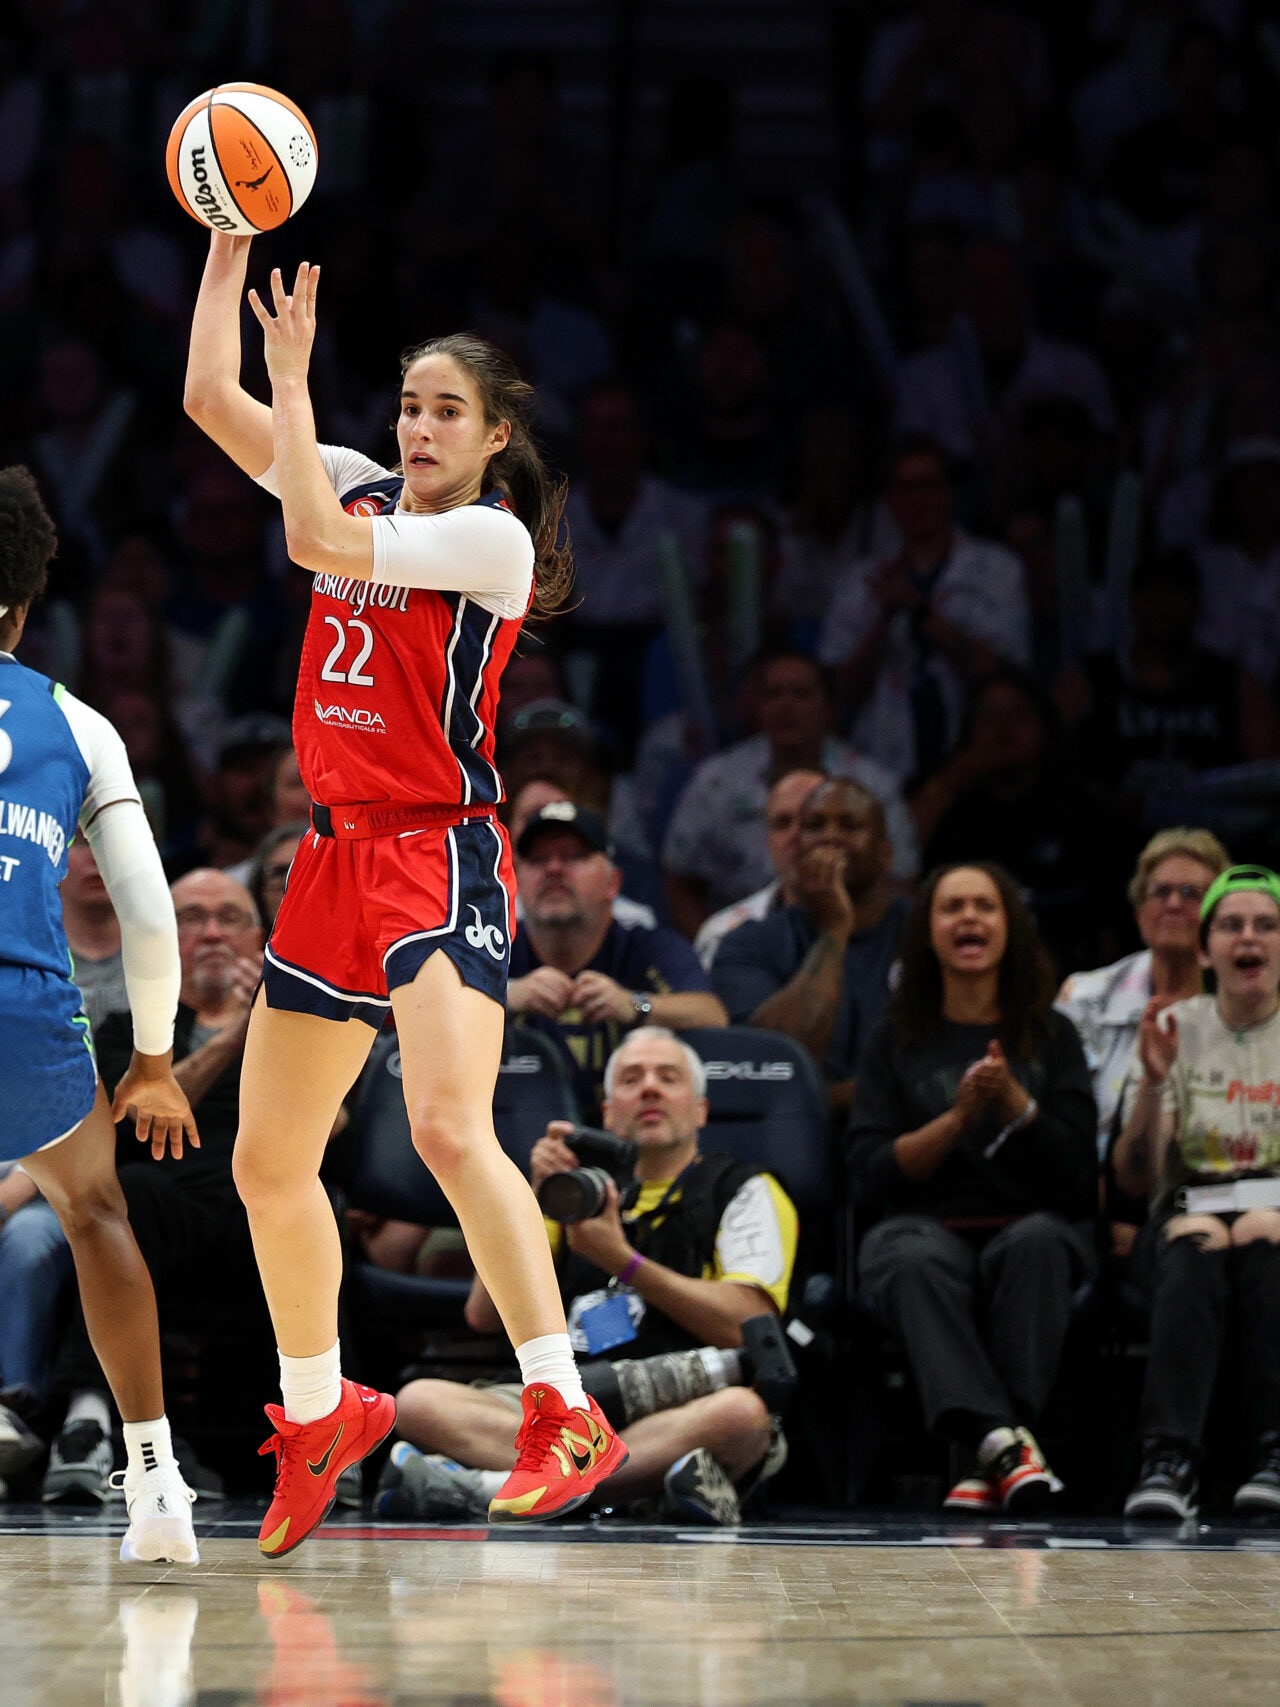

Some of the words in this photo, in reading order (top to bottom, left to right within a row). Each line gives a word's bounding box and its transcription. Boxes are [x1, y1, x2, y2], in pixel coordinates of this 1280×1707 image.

[190, 144, 238, 232] Wilson
[320, 615, 375, 687] 22
[703, 1060, 794, 1080] EXUS
